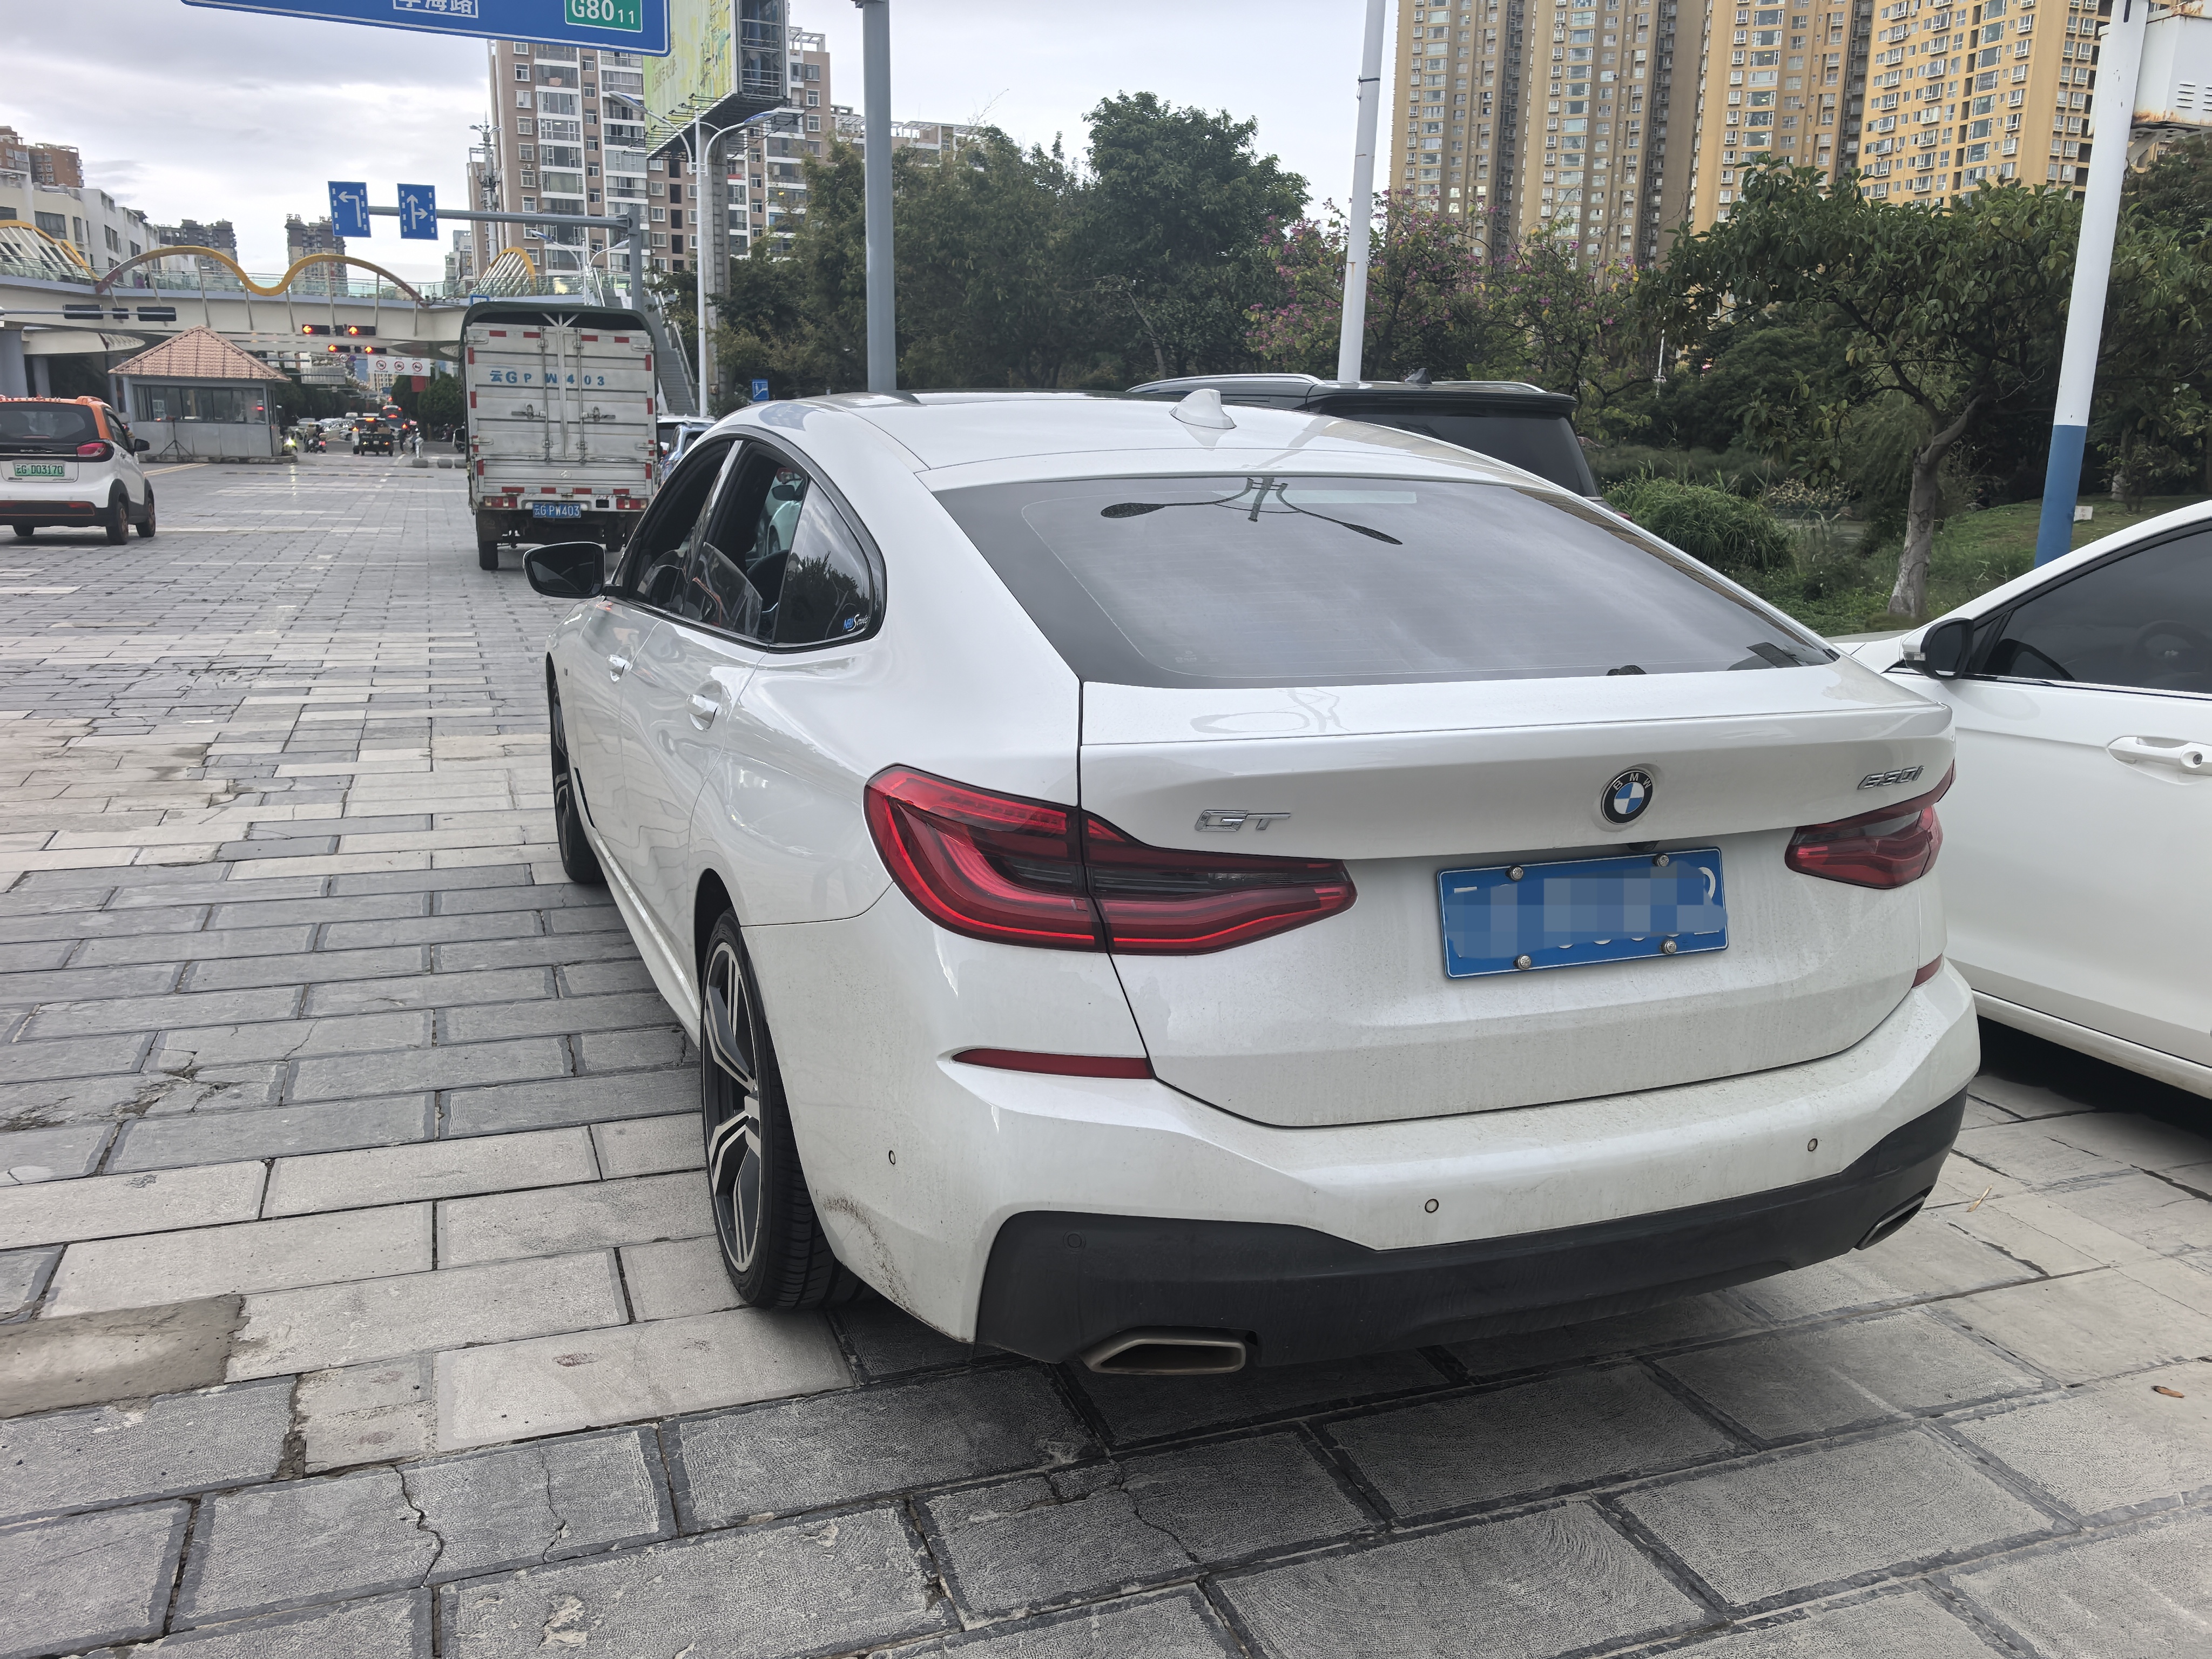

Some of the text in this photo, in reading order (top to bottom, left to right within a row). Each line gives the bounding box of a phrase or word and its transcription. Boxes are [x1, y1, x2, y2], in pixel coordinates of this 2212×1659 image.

[1613, 773, 1652, 791] BMW
[1857, 765, 1925, 790] 630i
[1195, 810, 1292, 831] GT
